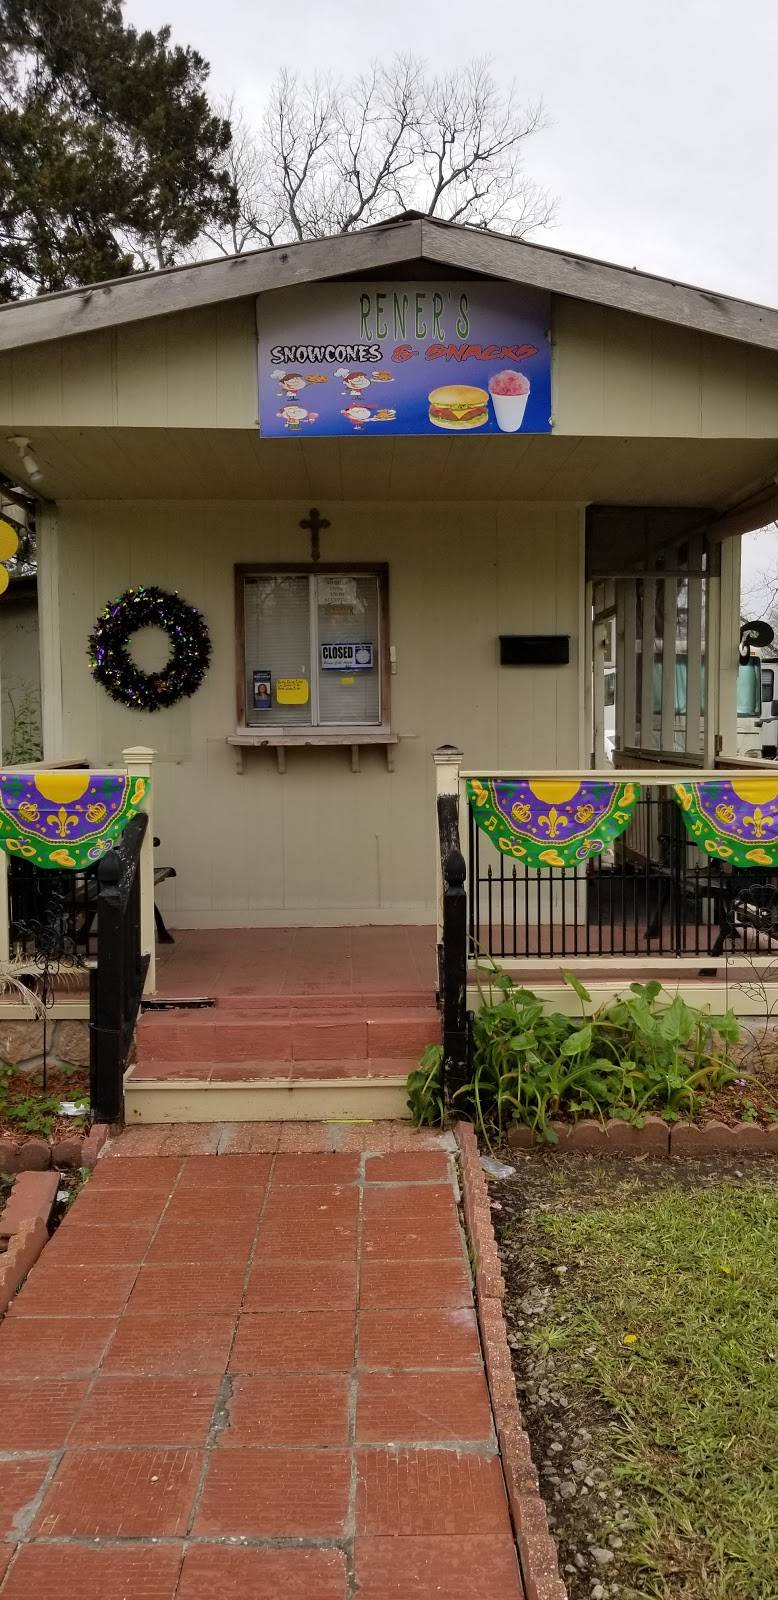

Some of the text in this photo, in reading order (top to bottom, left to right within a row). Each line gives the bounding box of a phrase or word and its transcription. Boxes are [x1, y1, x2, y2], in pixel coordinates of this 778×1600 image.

[360, 292, 470, 342] RENER'S
[271, 343, 540, 364] SNOWCONES & SNACKS
[322, 646, 353, 659] CLOSED
